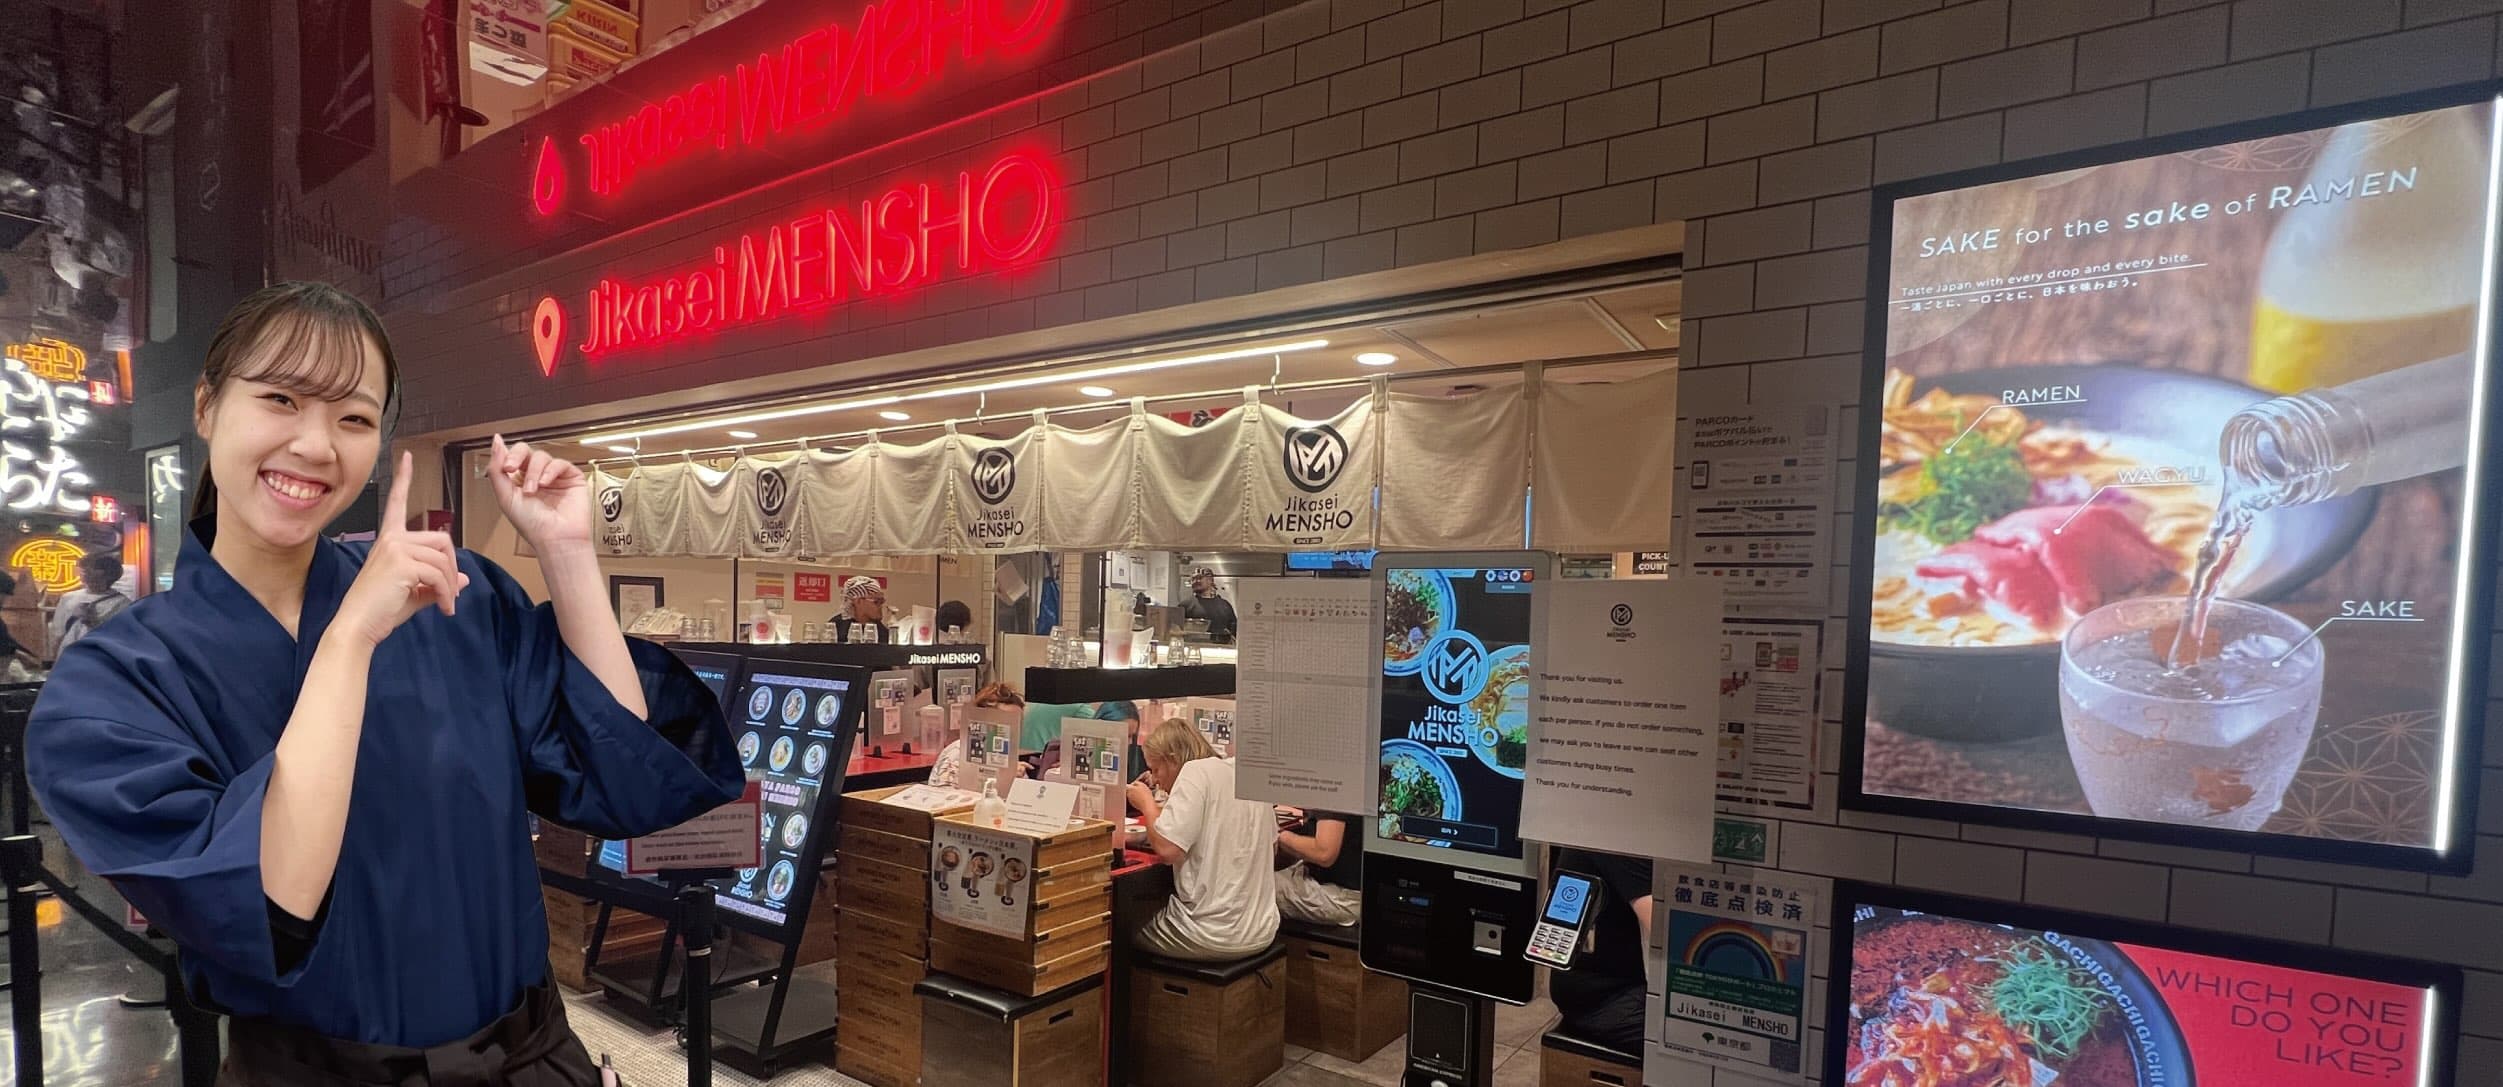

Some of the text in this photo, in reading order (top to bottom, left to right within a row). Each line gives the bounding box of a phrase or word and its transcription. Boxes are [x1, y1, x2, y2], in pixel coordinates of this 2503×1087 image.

[1919, 166, 2418, 258] SAKE for the sake of RAMEN
[580, 154, 1049, 353] Jikasei MENSHO
[1901, 252, 2192, 298] Taste Japan with every drop and every bite.
[2002, 384, 2081, 404] RAMEN
[2117, 466, 2207, 484] WAGYU
[976, 507, 1016, 522] Jikasei
[1285, 493, 1339, 513] Jikasei
[966, 520, 1024, 538] MENSHO
[1265, 509, 1354, 533] MENSHO
[752, 529, 792, 546] MENSHO
[2341, 600, 2416, 617] SAKE
[908, 652, 981, 665] Jikasei MENSHO
[1423, 706, 1483, 725] Jikasei
[1407, 721, 1499, 748] MENSHO
[1678, 874, 1801, 902] 飲食店等感染防止
[1674, 886, 1803, 921] 徹底点検済
[2155, 966, 2409, 1027] WHICH ONE
[1676, 1001, 1727, 1023] Jikasei
[1742, 1013, 1789, 1036] MENSHO
[2230, 1004, 2405, 1053] DO YOU
[1717, 1036, 1752, 1052] 東京都
[2275, 1037, 2404, 1079] LIKE?
